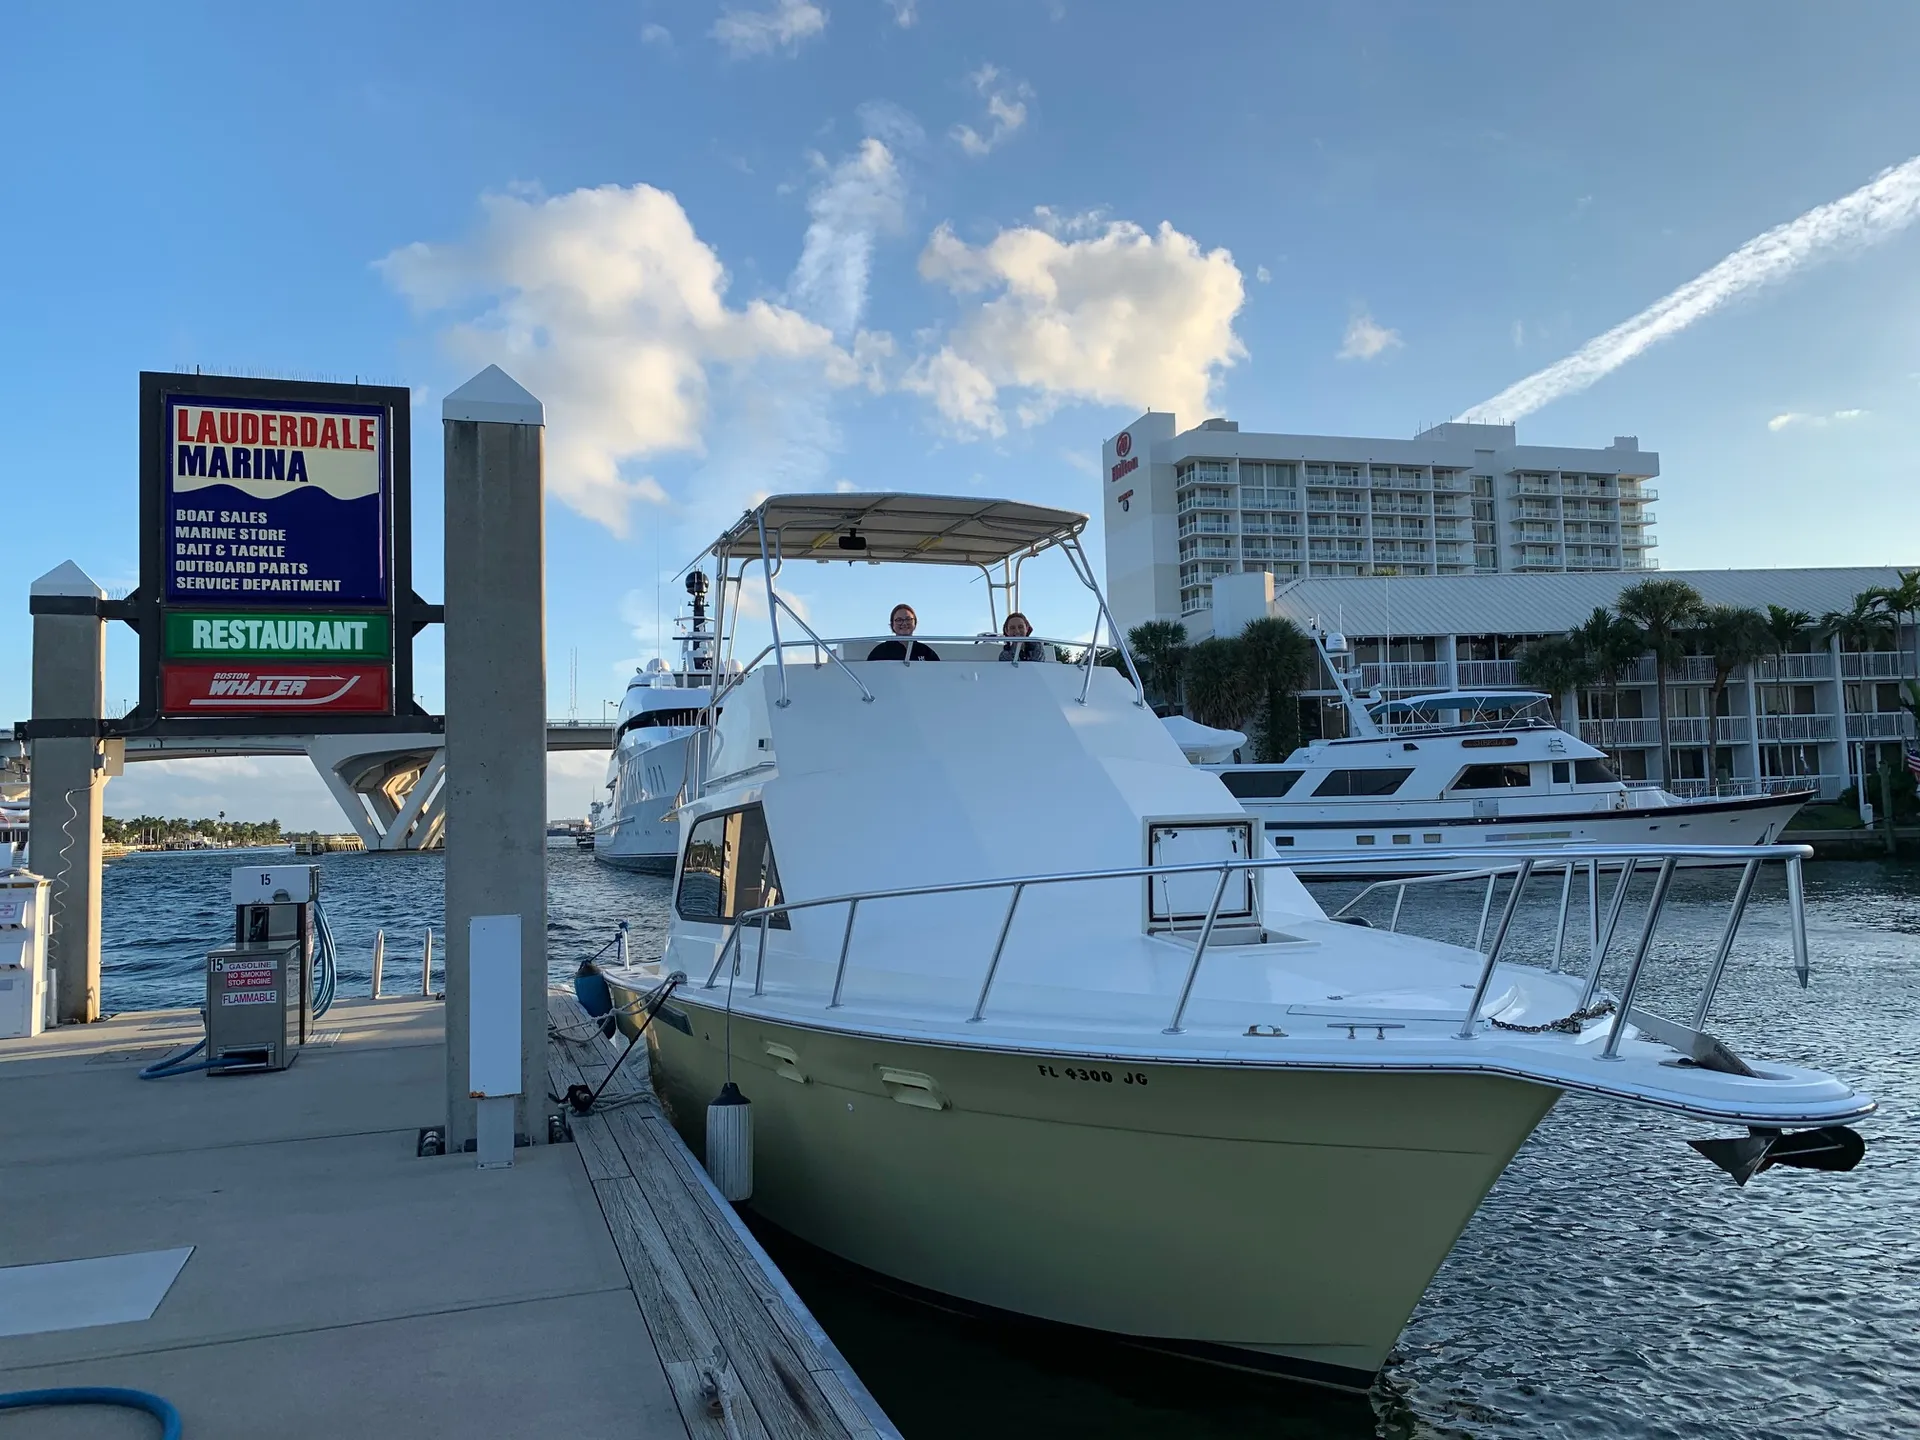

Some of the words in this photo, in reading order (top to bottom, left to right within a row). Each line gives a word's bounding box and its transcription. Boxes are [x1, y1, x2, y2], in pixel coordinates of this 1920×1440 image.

[177, 409, 375, 451] LAUDERDALE
[177, 445, 309, 482] MARINA
[1111, 456, 1139, 482] Hilton
[176, 509, 215, 522] BOAT
[220, 511, 268, 524] SALES
[175, 526, 236, 540] MARINE
[239, 528, 286, 541] STORE
[176, 543, 212, 556] BAIT
[215, 544, 226, 556] &
[230, 544, 285, 558] TACKLE
[175, 560, 256, 574] OUTBOARD
[259, 562, 308, 574] PARTS
[176, 576, 239, 590] SERVICE
[242, 578, 341, 592] DEPARTMENT
[192, 619, 368, 650] RESTAURANT
[213, 672, 250, 680] BOSTON
[208, 680, 307, 696] WHALER
[260, 873, 271, 886] 15
[211, 958, 223, 972] 15
[228, 961, 272, 970] GASOLINE
[227, 979, 245, 987] STOP
[247, 977, 271, 985] ENGINE
[240, 970, 271, 979] SMOKING
[223, 992, 275, 1005] FLAMMABLE
[1037, 1064, 1059, 1078] FL
[1064, 1067, 1113, 1083] 4300
[1123, 1072, 1148, 1086] JG
